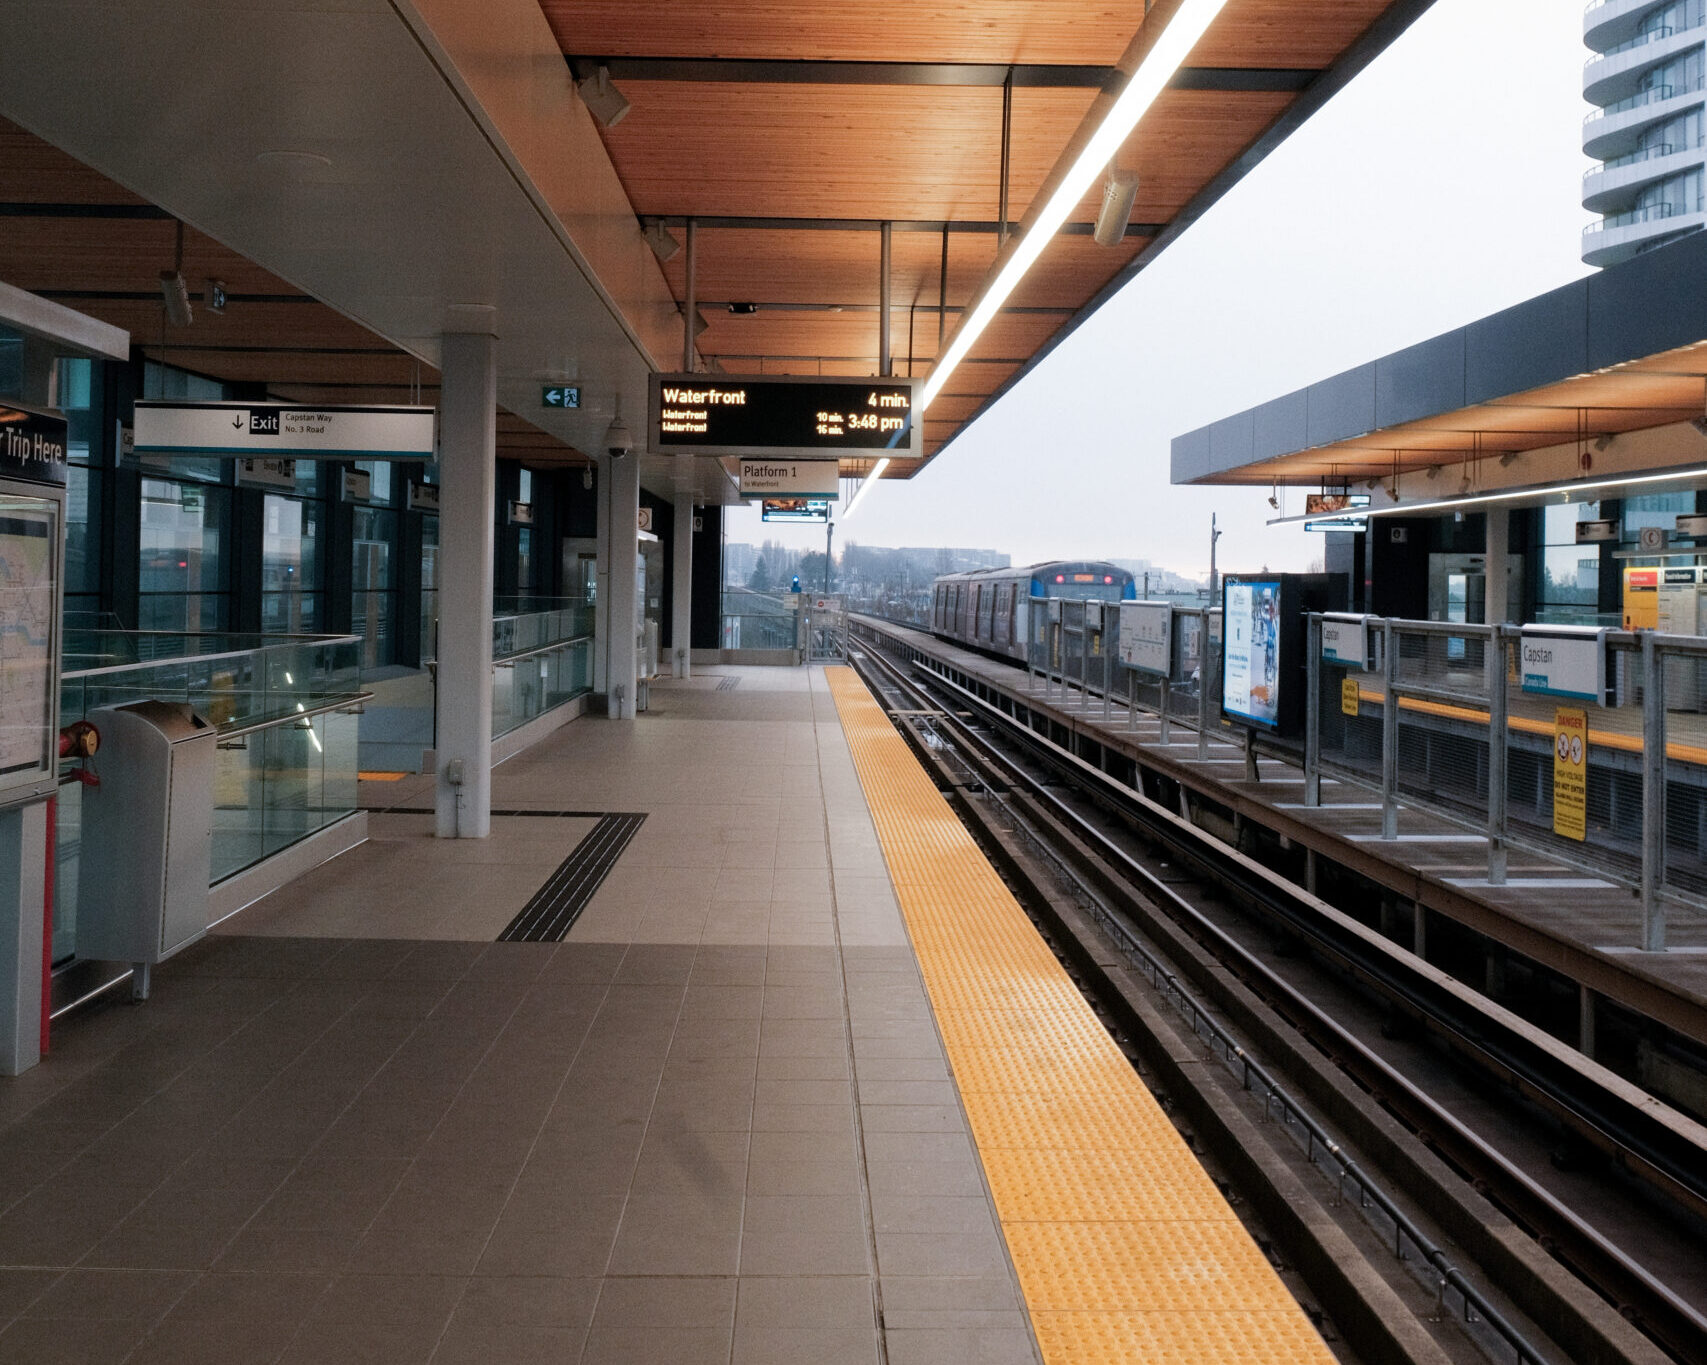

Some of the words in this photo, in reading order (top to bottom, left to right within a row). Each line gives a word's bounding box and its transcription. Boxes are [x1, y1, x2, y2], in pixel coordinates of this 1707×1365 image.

[663, 388, 746, 405] Waterfront
[868, 392, 878, 407] 4
[880, 393, 910, 408] min.
[251, 415, 279, 430] Exit
[285, 413, 315, 423] Capstan
[316, 414, 333, 424] Way
[662, 409, 708, 420] Waterfront
[816, 411, 828, 422] 10
[285, 425, 297, 433] No.
[306, 426, 325, 434] Road
[662, 421, 708, 433] Waterfront
[848, 413, 878, 430] 3:48
[880, 416, 904, 433] pm
[6, 426, 31, 466] Trip
[34, 432, 62, 465] Here
[744, 465, 788, 478] Platform
[791, 466, 797, 478] 1
[1523, 644, 1553, 666] Capstan
